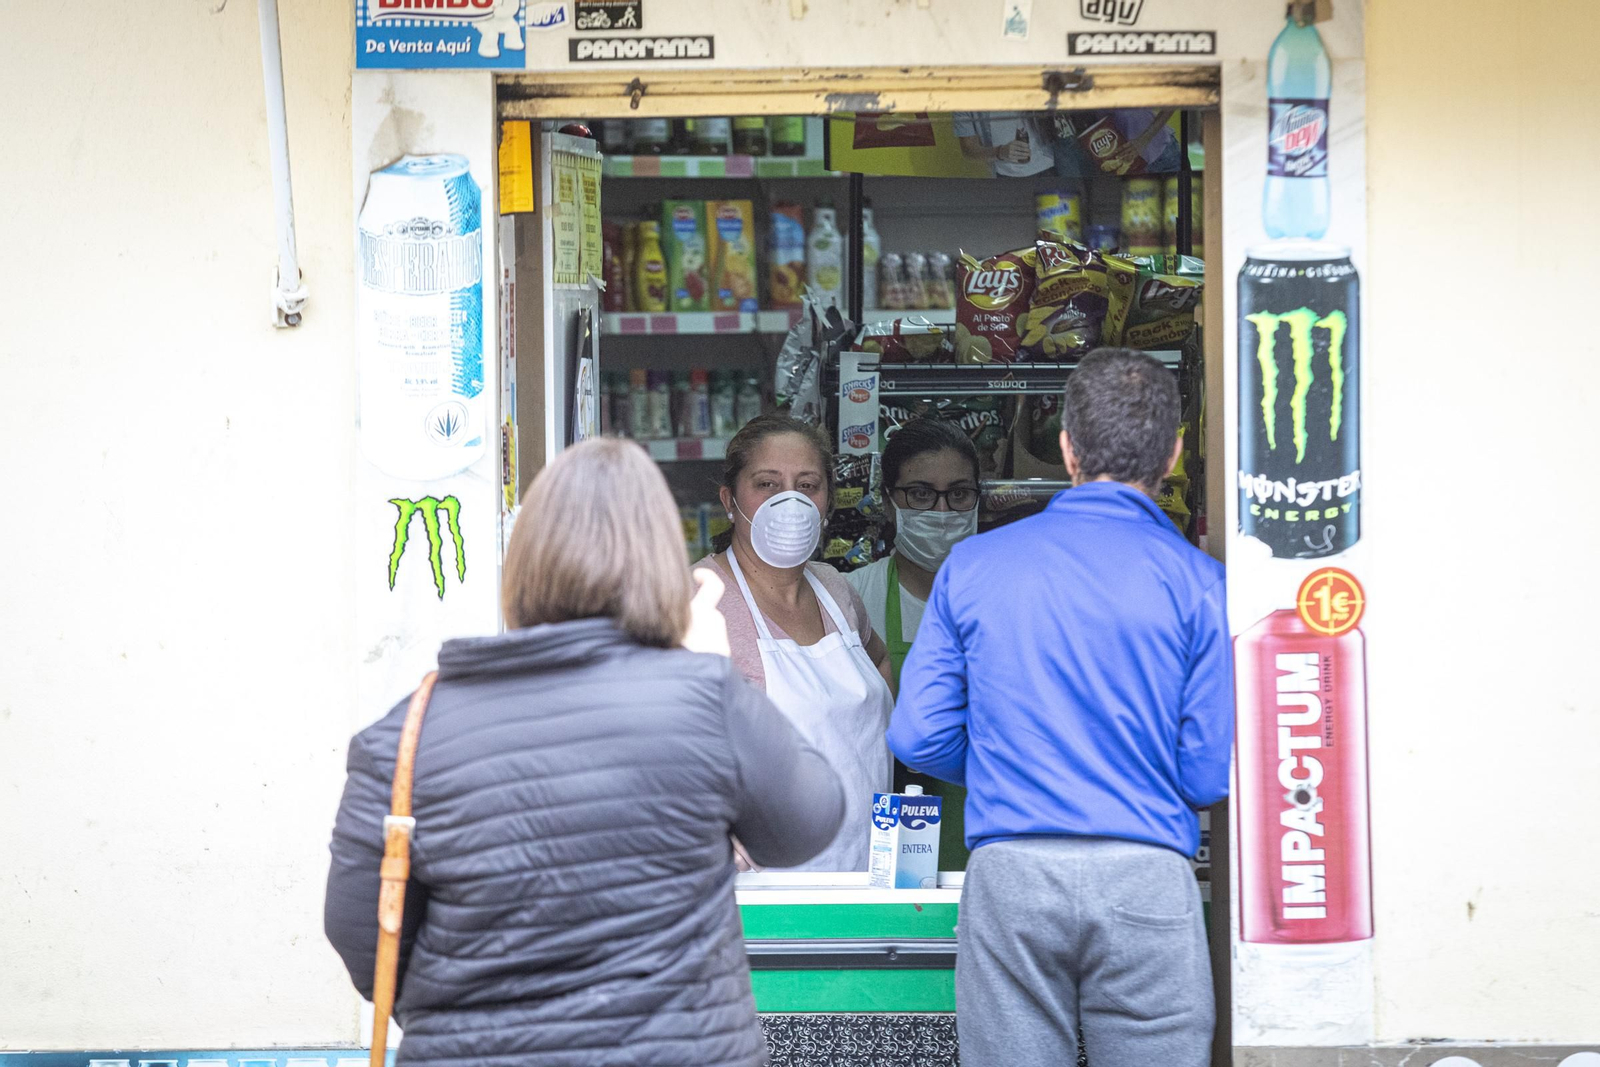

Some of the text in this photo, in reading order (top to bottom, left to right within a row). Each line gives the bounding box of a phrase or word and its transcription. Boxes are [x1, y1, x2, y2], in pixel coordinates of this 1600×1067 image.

[366, 36, 471, 56] De Venta Aquí
[967, 268, 1021, 299] Lay's
[972, 313, 983, 323] Al
[977, 323, 989, 332] de
[1129, 321, 1172, 341] Pack
[843, 379, 872, 394] SNACKS
[959, 409, 999, 431] ritos
[843, 425, 872, 440] SNACKS
[1250, 502, 1352, 521] ENERGY
[1322, 656, 1335, 748] ENERGY DRINK
[1275, 652, 1327, 920] IMPACTUM
[901, 804, 940, 817] PULEVA
[902, 843, 933, 854] ENTERA
